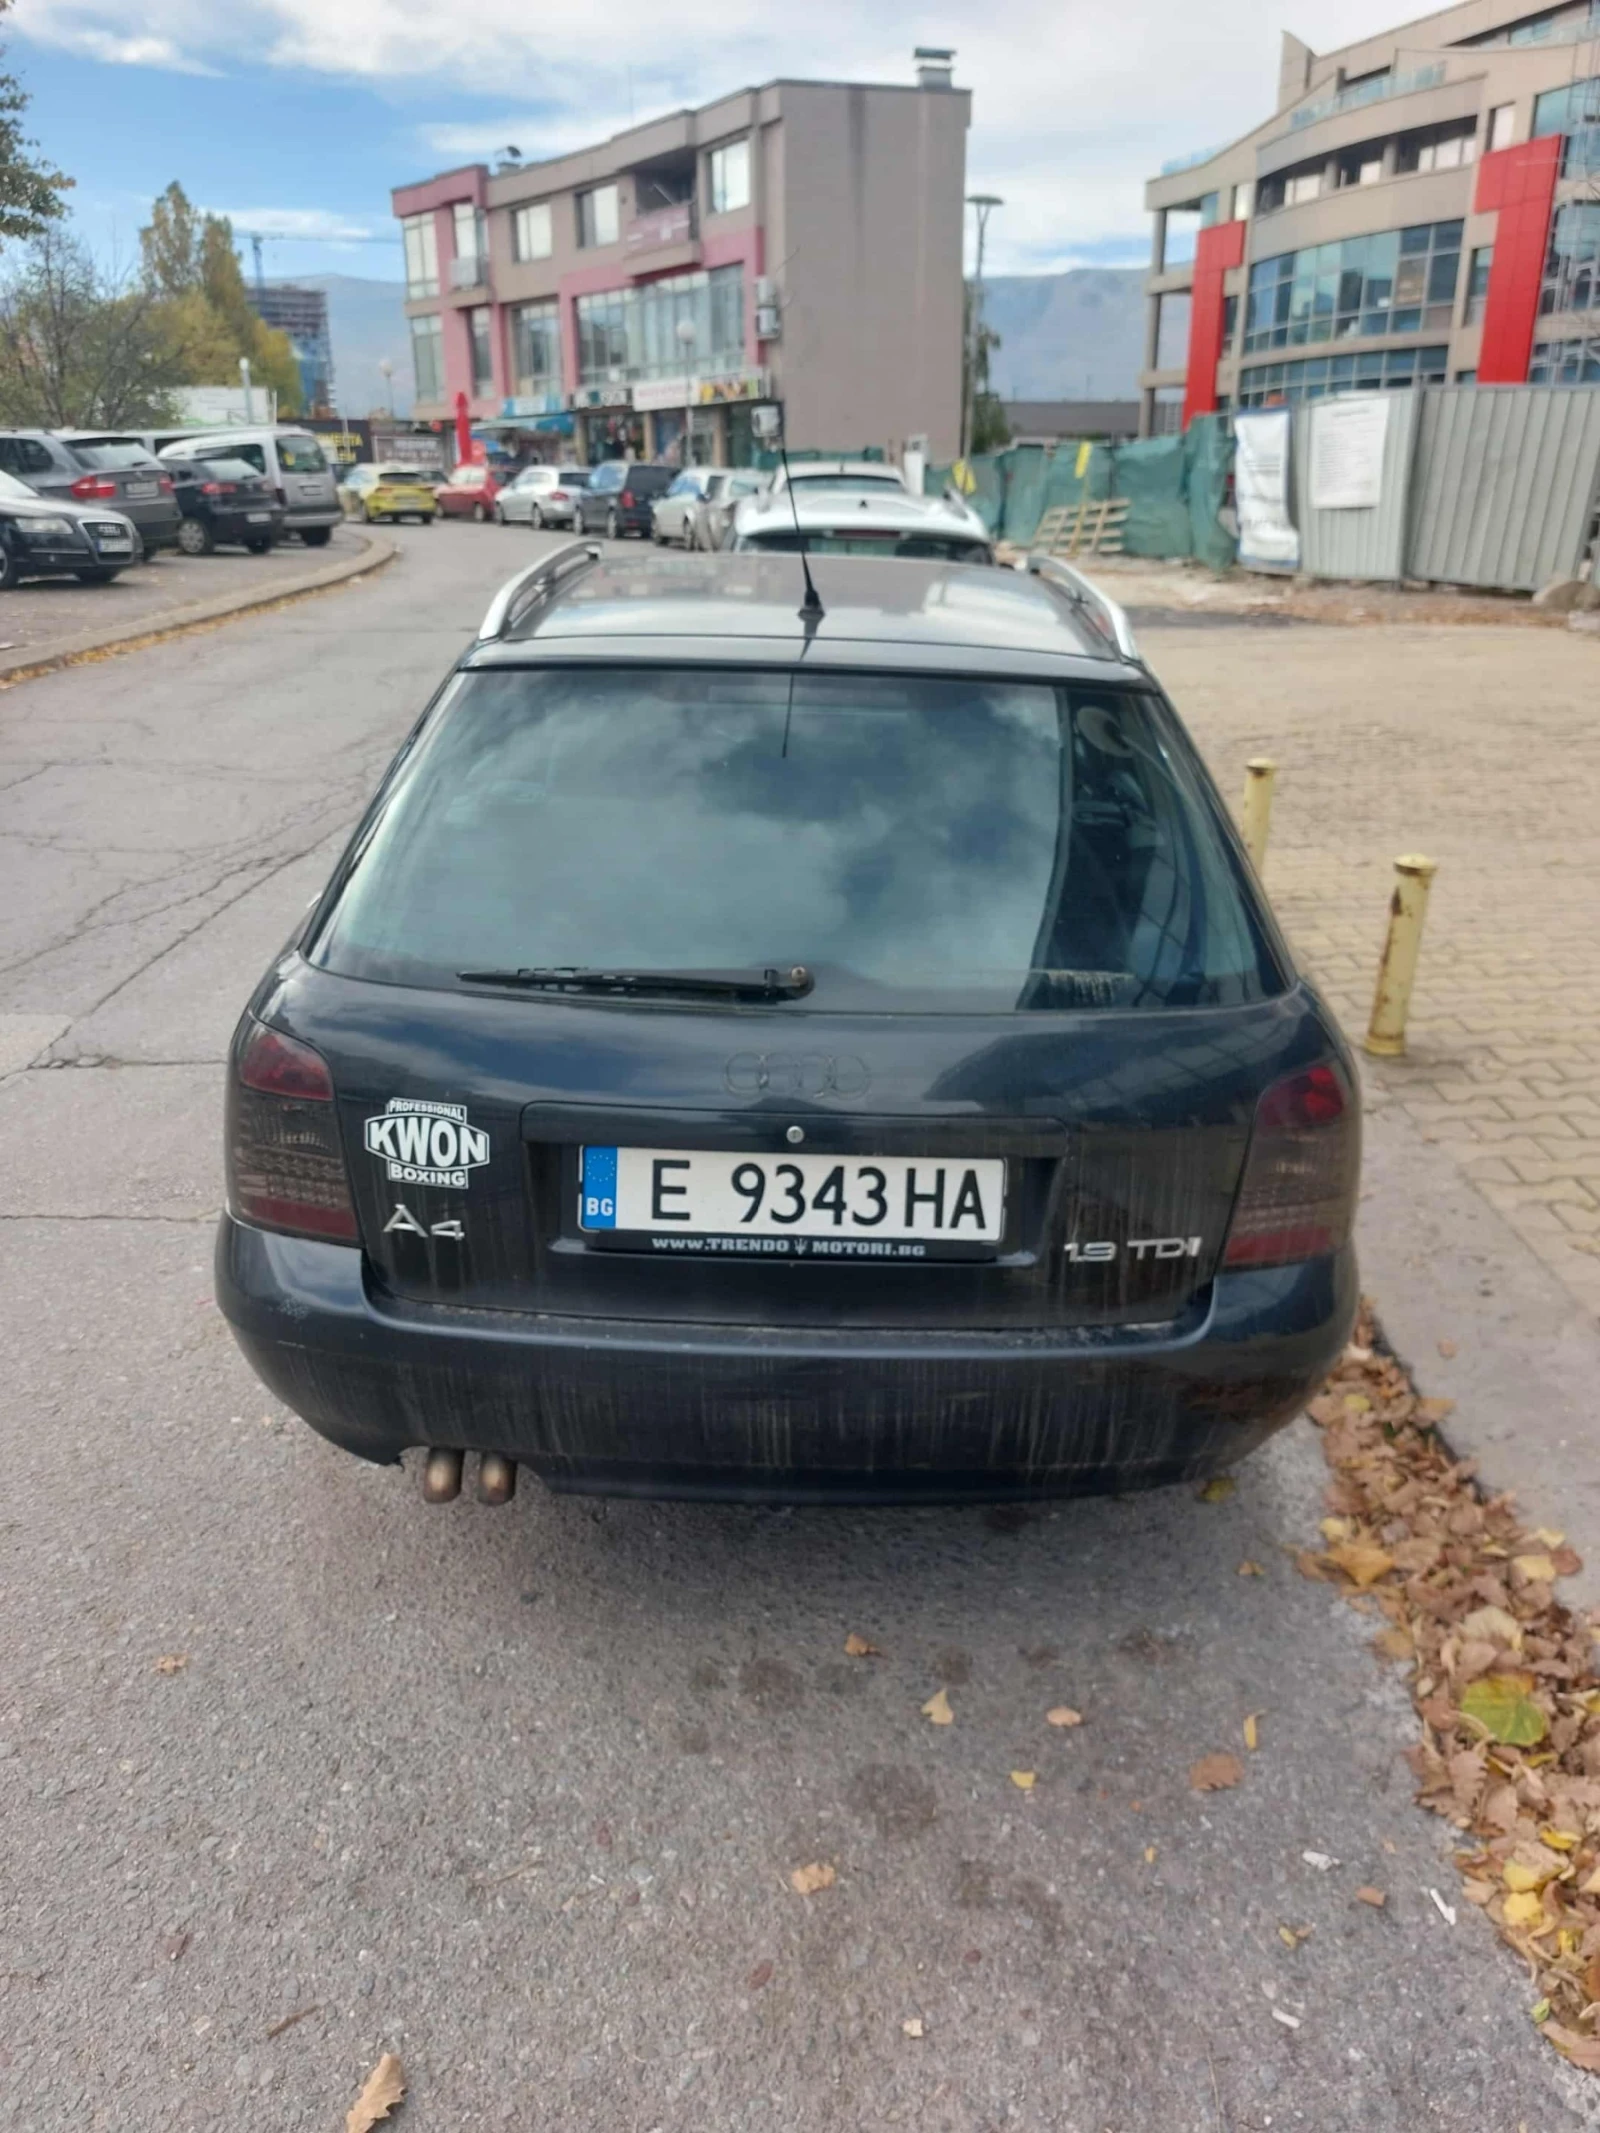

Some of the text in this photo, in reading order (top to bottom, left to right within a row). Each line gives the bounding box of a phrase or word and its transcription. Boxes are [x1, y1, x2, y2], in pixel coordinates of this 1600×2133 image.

[389, 1099, 464, 1121] PROFESSIONAL
[369, 1116, 486, 1168] KWON
[390, 1162, 466, 1186] BOXING
[586, 1197, 614, 1216] BG
[651, 1159, 987, 1230] E 9343 HA
[383, 1203, 465, 1241] A4
[1127, 1236, 1202, 1261] TDI
